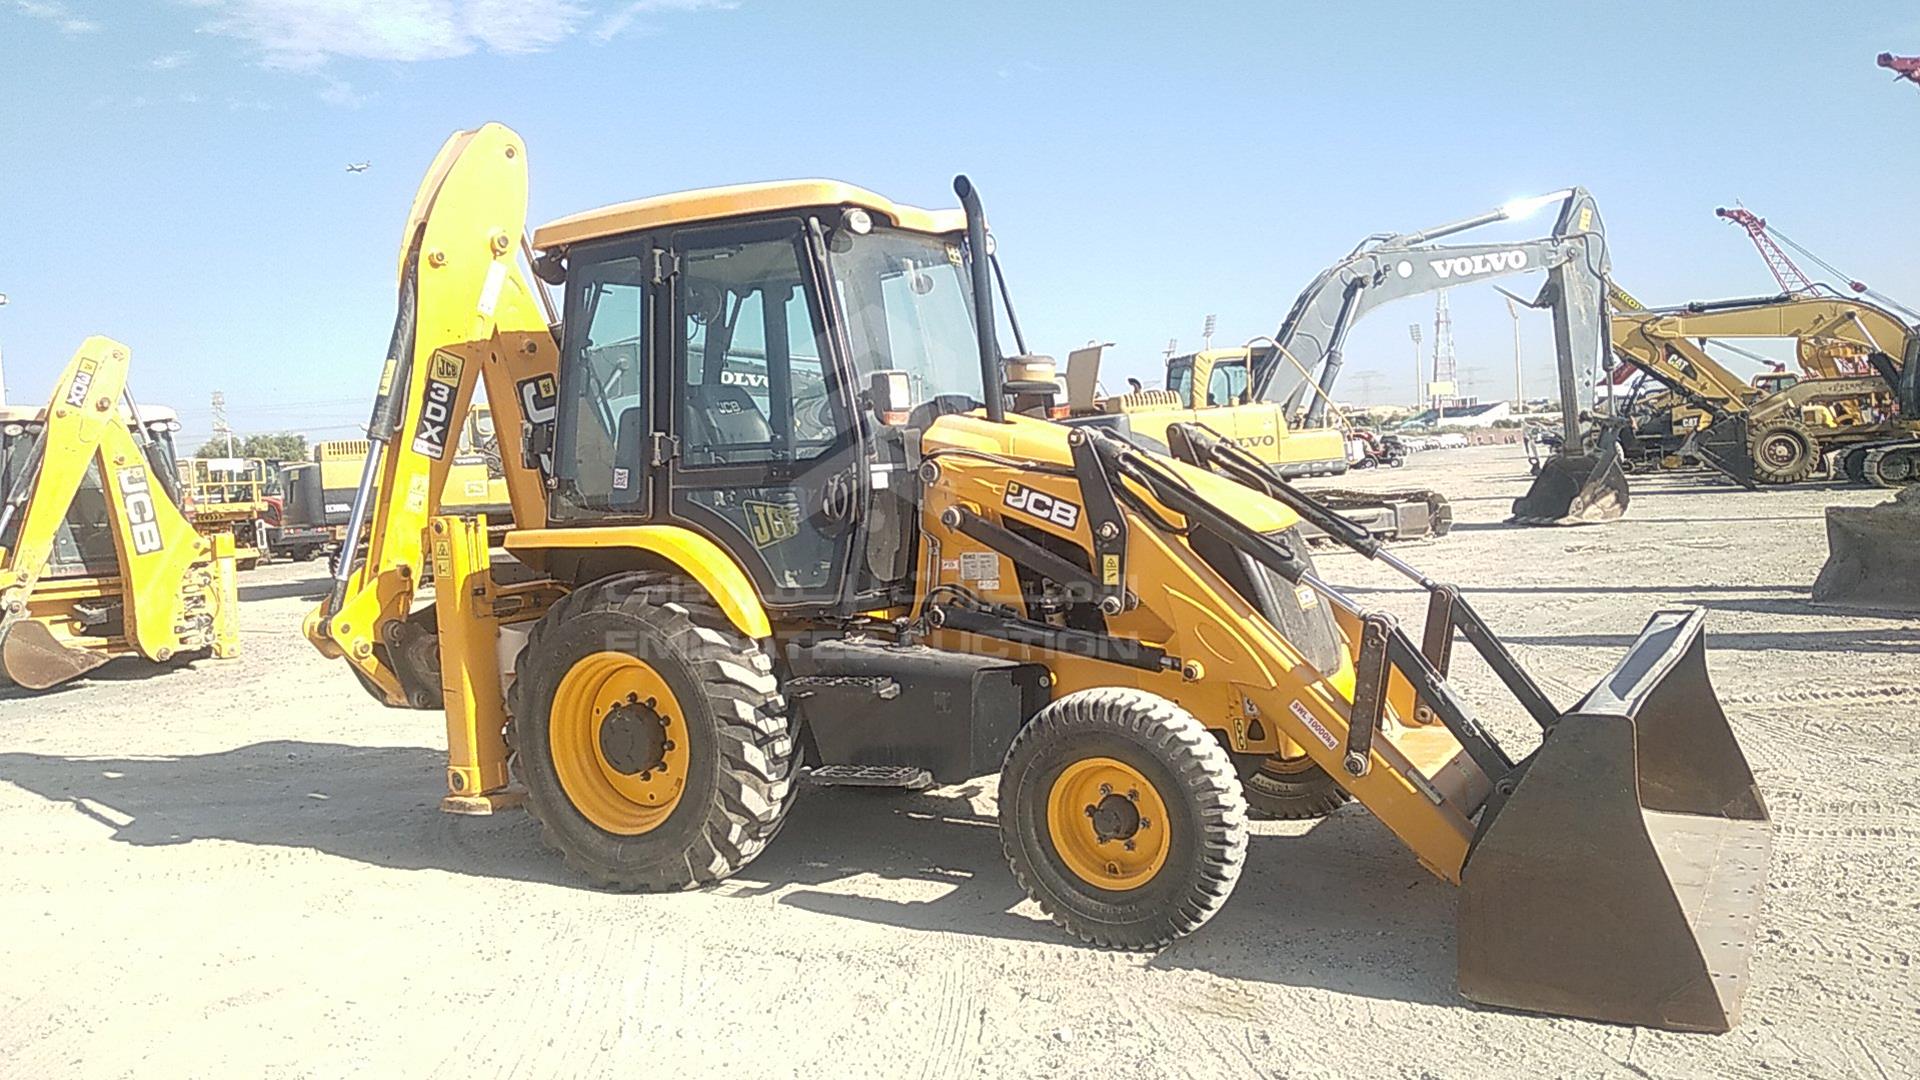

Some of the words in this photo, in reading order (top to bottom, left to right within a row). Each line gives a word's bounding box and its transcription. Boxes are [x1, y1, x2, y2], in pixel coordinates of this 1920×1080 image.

[1429, 250, 1527, 278] VOLVO
[437, 354, 458, 379] JCB
[1667, 353, 1689, 371] CAT
[720, 371, 769, 387] OLV
[418, 382, 450, 444] 3DX
[1682, 418, 1698, 427] CAT
[118, 470, 161, 554] JCB
[1005, 487, 1078, 528] JCB
[1292, 702, 1308, 720] SWL
